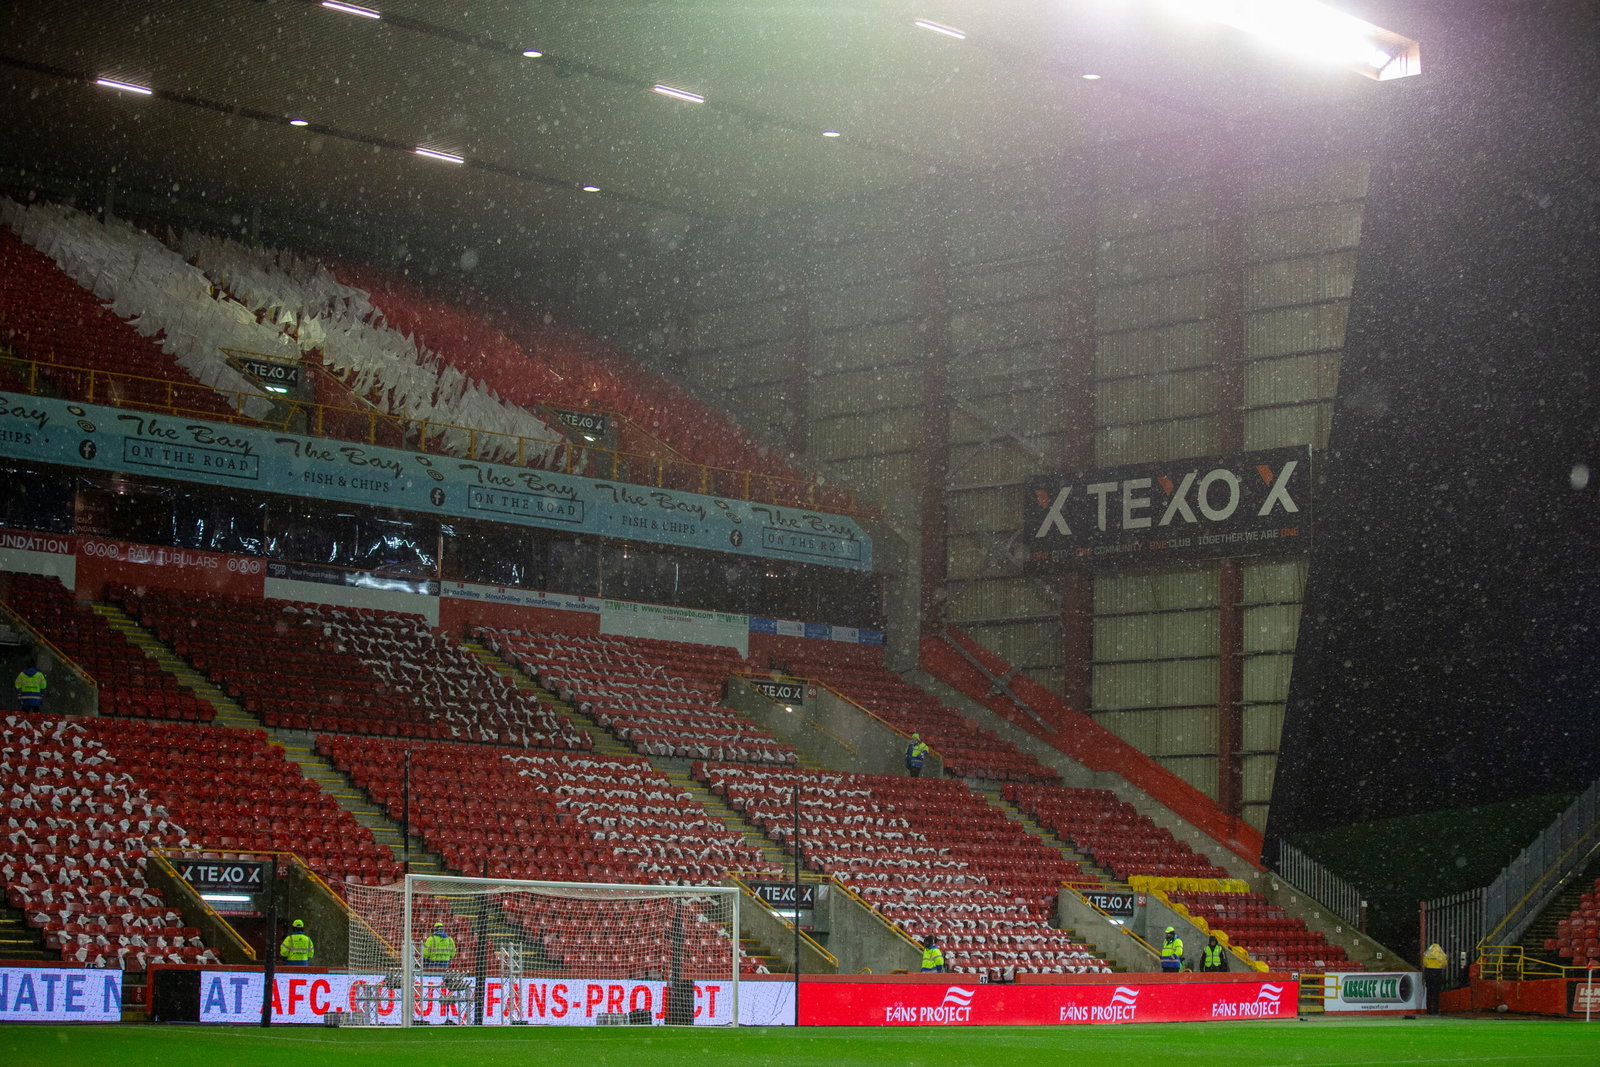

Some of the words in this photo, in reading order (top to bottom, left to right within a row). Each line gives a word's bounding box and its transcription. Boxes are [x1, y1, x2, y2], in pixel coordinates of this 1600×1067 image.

[252, 363, 285, 379] TEXO
[117, 414, 180, 440] The
[187, 425, 252, 457] Bay
[132, 445, 154, 458] ON
[162, 449, 195, 464] THE
[204, 455, 249, 471] ROAD
[275, 438, 335, 462] The
[340, 447, 404, 478] Bay
[303, 471, 333, 486] FISH
[338, 476, 347, 487] &
[351, 478, 390, 493] CHIPS
[458, 463, 515, 487] The
[518, 473, 577, 502] Bay
[475, 492, 494, 504] ON
[501, 496, 529, 509] THE
[536, 501, 576, 516] ROAD
[595, 484, 648, 506] The
[651, 492, 706, 521] Bay
[1087, 467, 1241, 533] TEXO
[621, 515, 648, 529] FISH
[651, 519, 658, 530] &
[662, 520, 696, 534] CHIPS
[752, 506, 800, 528] The
[802, 515, 855, 542] Bay
[768, 533, 784, 545] ON
[790, 537, 815, 549] THE
[821, 541, 854, 554] ROAD
[1094, 543, 1142, 557] COMMUNITY
[1168, 537, 1191, 549] CLUB
[1245, 531, 1259, 542] WE
[1260, 529, 1279, 540] ARE
[1280, 527, 1300, 539] ONE
[128, 546, 154, 564] RAM
[158, 550, 219, 569] TUBULARS
[763, 684, 791, 698] TEXO
[197, 866, 244, 882] TEXO
[277, 866, 288, 876] 45
[1094, 896, 1122, 909] TEXO
[1138, 896, 1146, 904] 50
[203, 976, 249, 1014] AT
[1380, 979, 1397, 998] LTD
